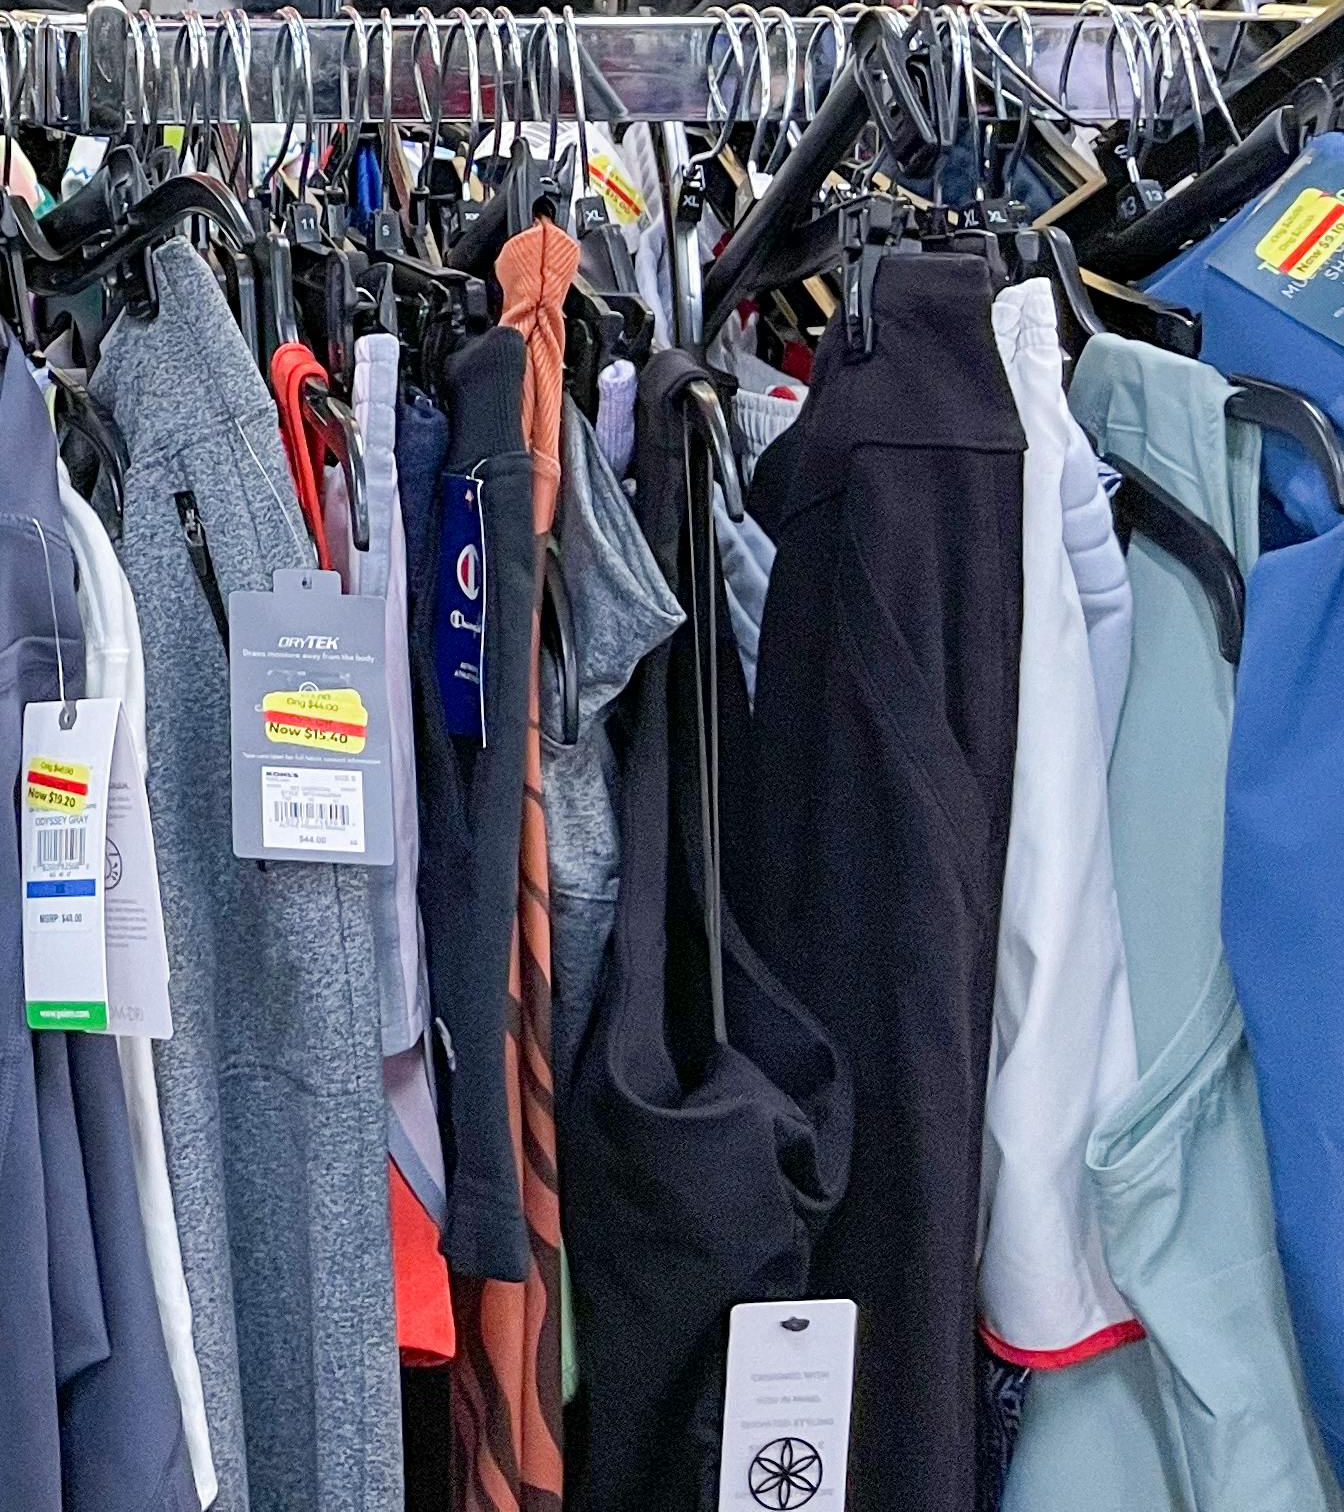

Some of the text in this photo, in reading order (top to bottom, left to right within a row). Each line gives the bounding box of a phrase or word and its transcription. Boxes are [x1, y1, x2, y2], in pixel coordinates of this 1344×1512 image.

[682, 194, 700, 208] XL
[585, 209, 605, 222] XL
[964, 209, 980, 228] XL
[987, 210, 1007, 223] XL
[301, 218, 315, 230] 11
[381, 225, 391, 236] S
[286, 696, 306, 709] Orig
[269, 721, 348, 744] Now $15.40
[28, 786, 76, 808] Now $19.20
[35, 814, 89, 826] ODYSSEY GRAY
